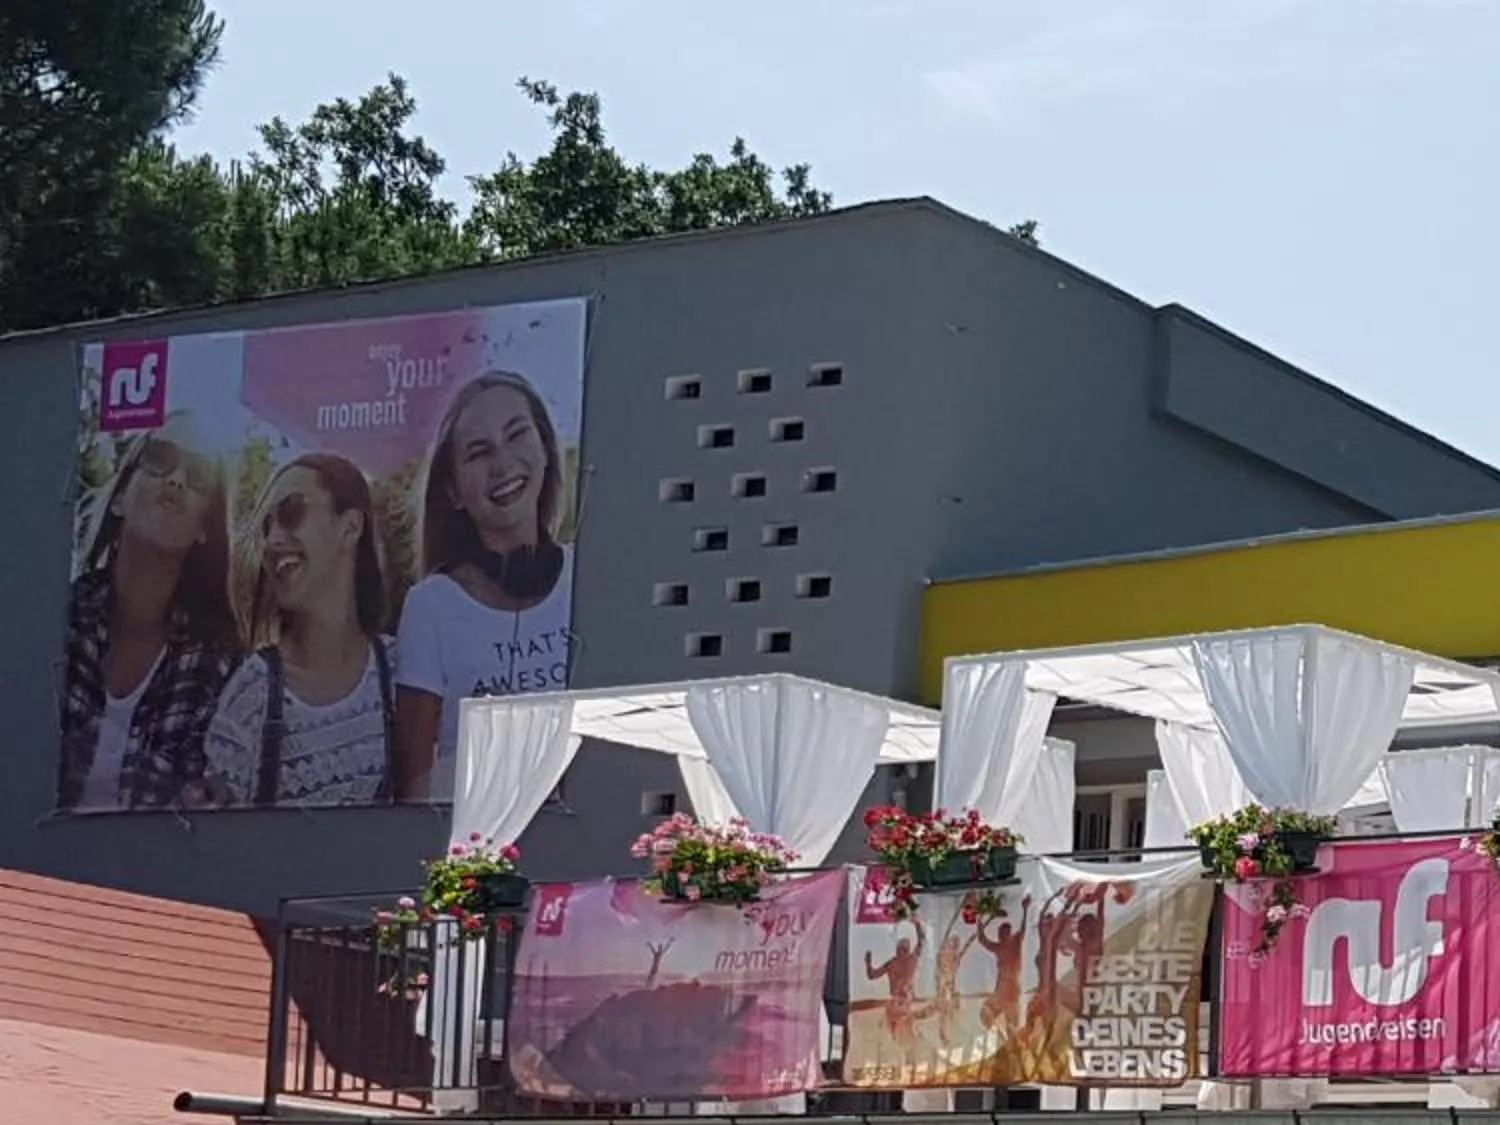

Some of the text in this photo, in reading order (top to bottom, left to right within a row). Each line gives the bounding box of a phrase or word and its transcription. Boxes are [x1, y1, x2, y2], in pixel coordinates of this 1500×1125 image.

[386, 357, 448, 397] your
[318, 393, 407, 430] moment
[1086, 952, 1193, 983] BESTE
[1082, 984, 1189, 1016] PARTY
[1071, 1016, 1187, 1048] DEINES
[1298, 1015, 1447, 1051] Jugendreisen
[1069, 1048, 1187, 1079] LEBENS
